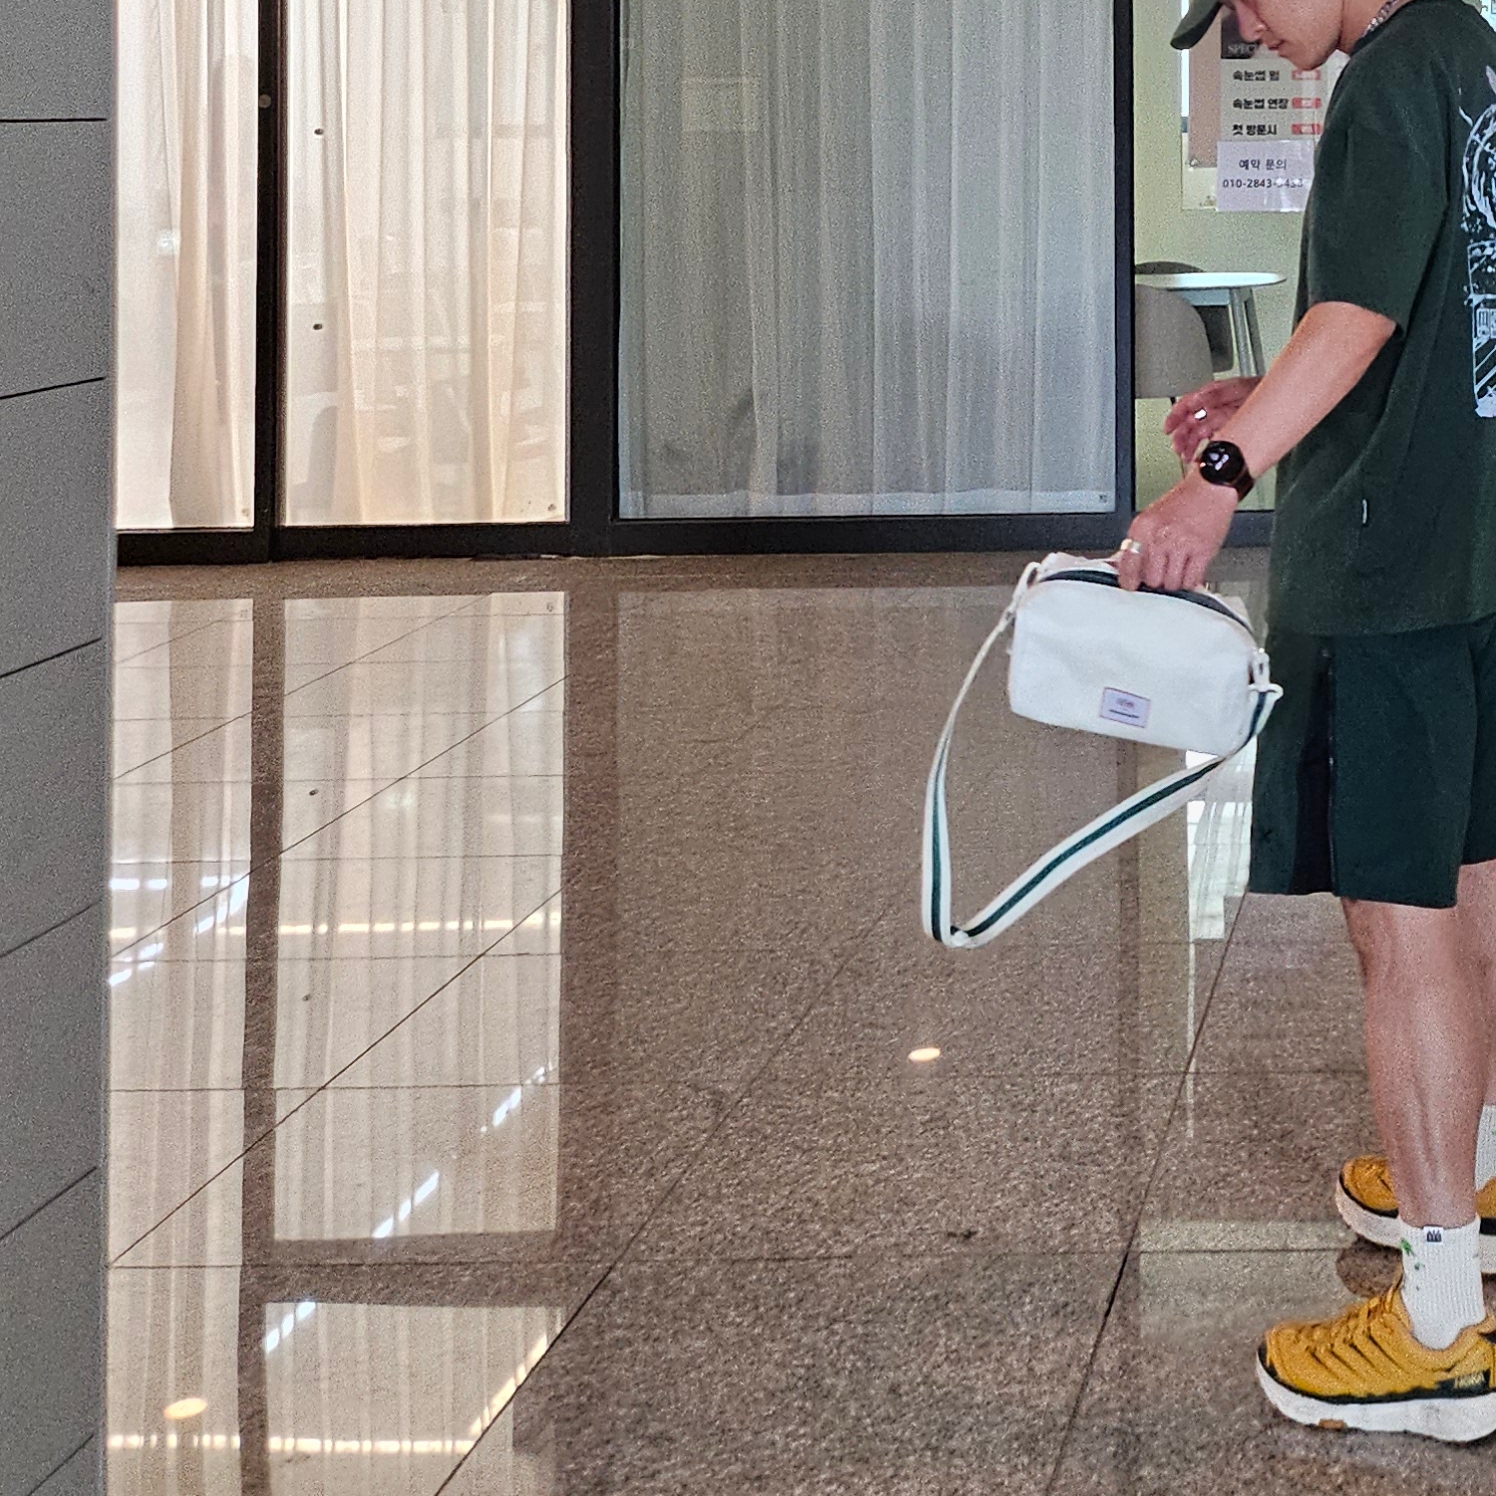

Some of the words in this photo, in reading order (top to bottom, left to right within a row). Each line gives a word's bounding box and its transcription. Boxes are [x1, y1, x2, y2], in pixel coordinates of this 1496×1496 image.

[1232, 124, 1244, 136] 첫
[1239, 159, 1261, 170] 예약
[1266, 159, 1287, 170] 문의
